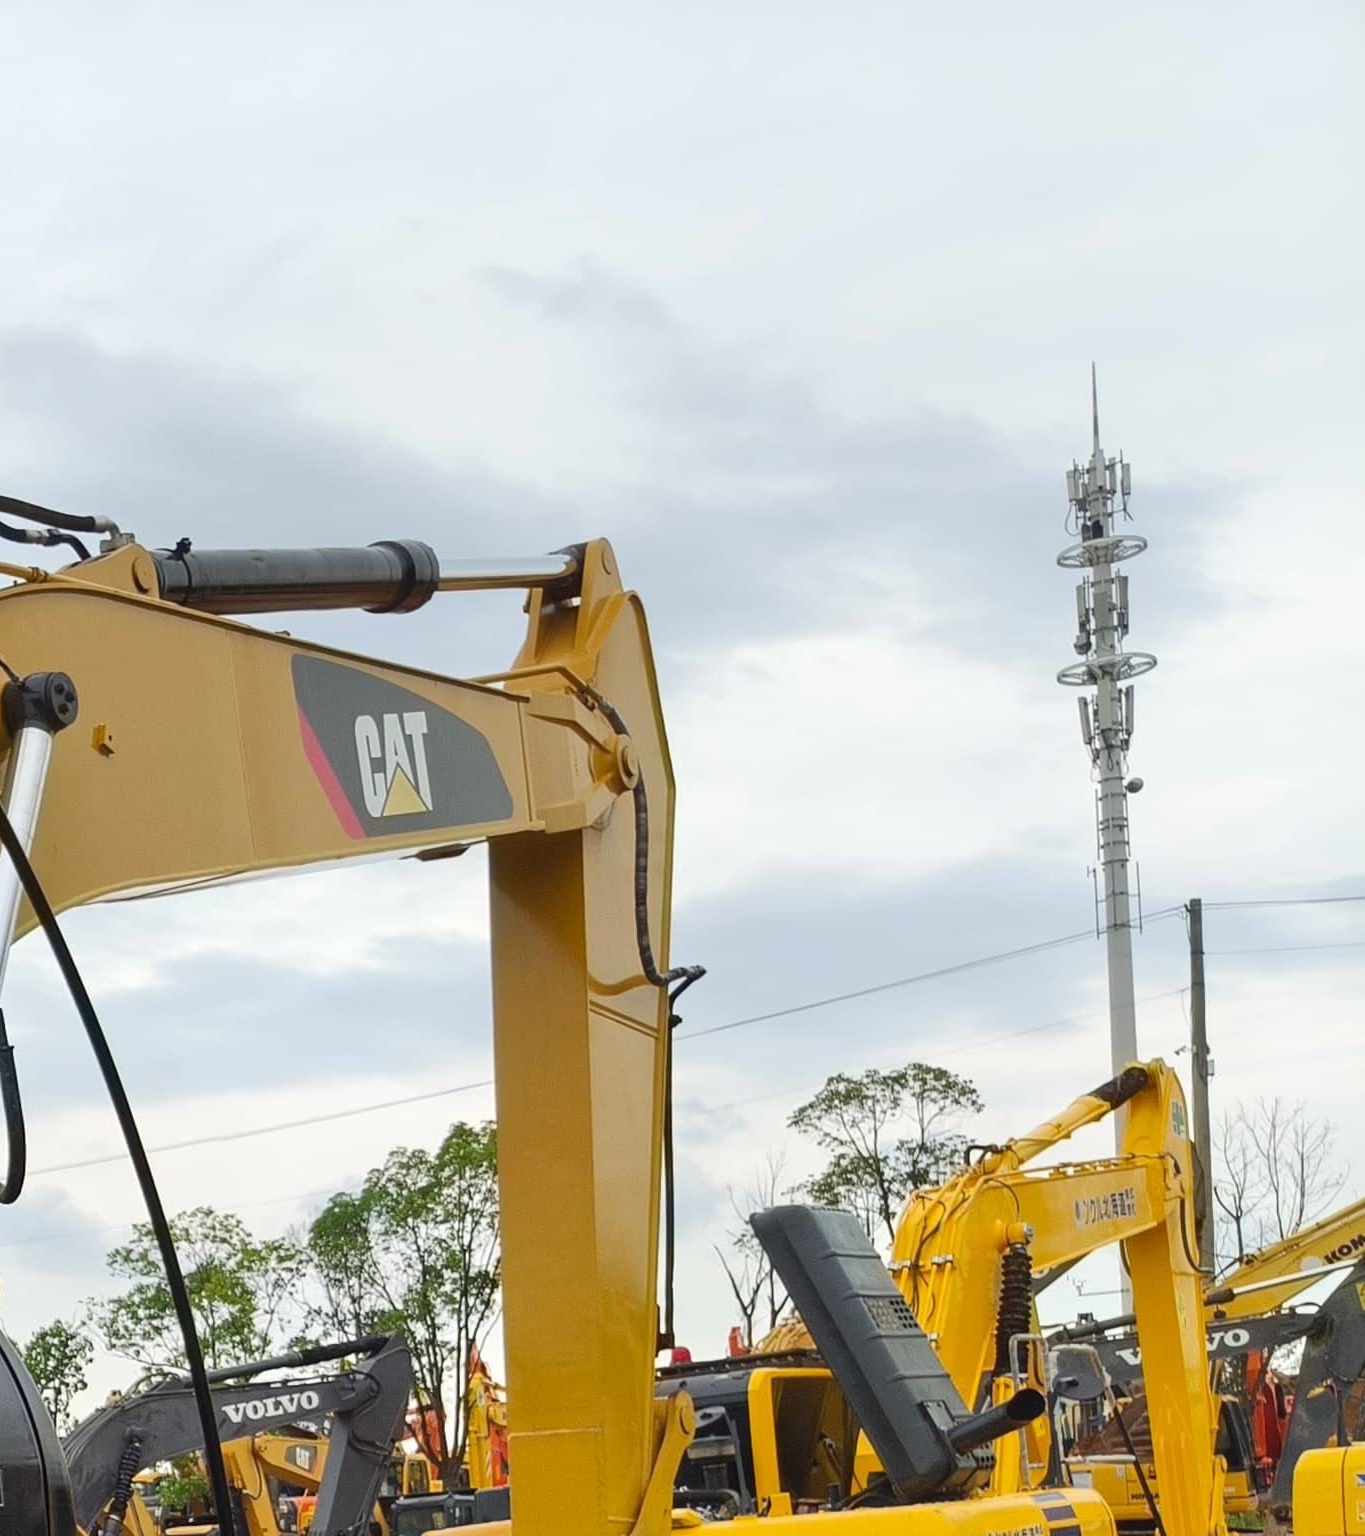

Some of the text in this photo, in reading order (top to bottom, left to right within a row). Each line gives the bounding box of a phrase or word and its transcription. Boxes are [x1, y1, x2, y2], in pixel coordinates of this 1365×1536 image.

[354, 711, 432, 818] CAT
[1115, 1328, 1249, 1365] VVO
[221, 1391, 319, 1423] VOLVO
